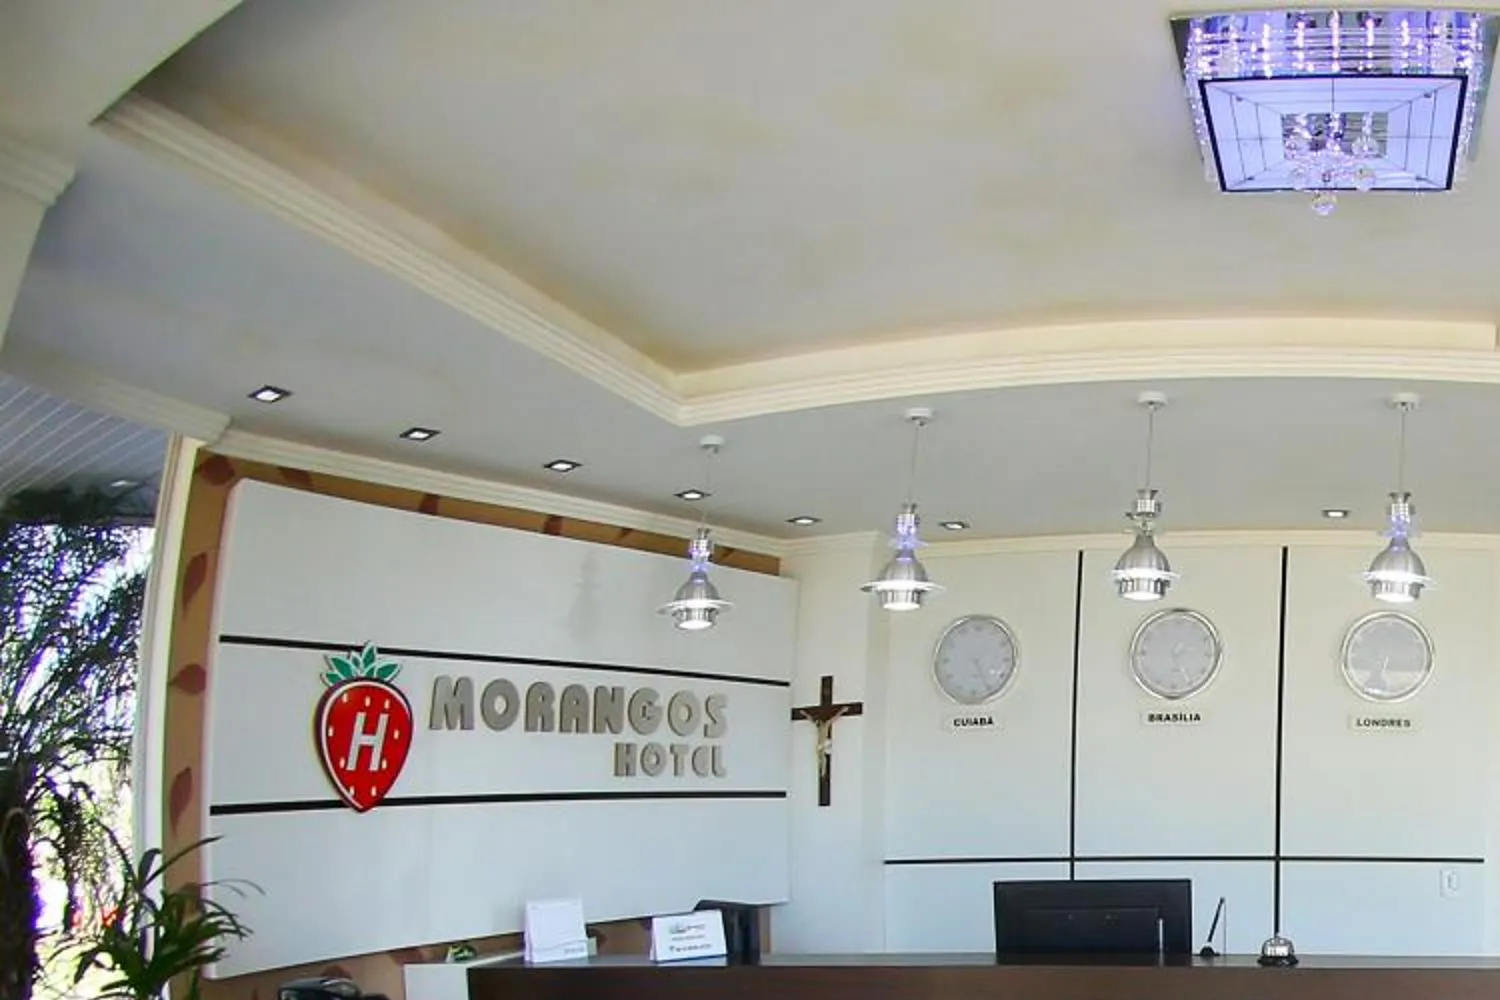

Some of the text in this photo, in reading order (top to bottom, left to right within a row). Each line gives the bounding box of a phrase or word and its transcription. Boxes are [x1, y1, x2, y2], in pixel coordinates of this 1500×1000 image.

[429, 675, 727, 738] MORANGOS
[346, 711, 389, 771] H
[614, 742, 727, 778] HOTEL
